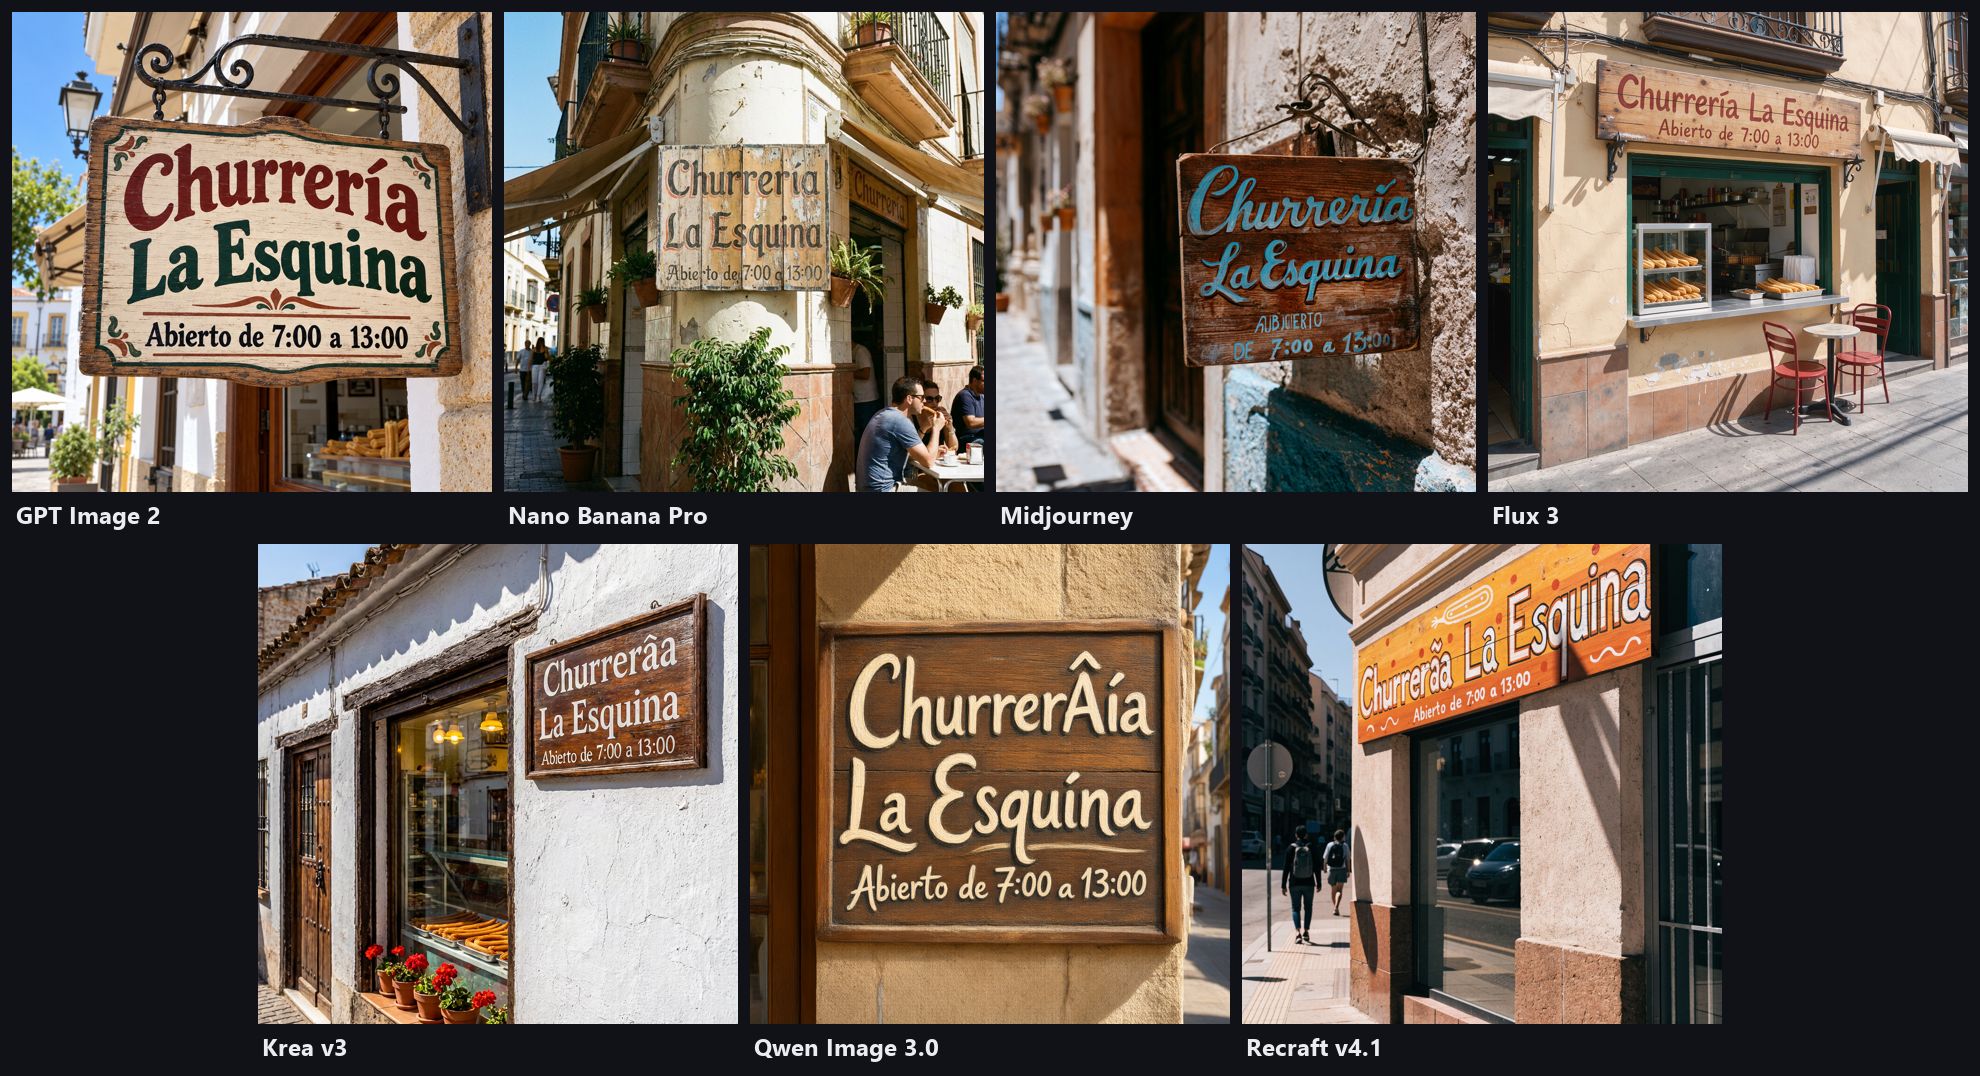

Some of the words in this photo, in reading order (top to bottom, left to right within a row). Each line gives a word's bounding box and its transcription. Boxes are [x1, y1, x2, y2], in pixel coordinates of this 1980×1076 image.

[1617, 73, 1739, 120] Churrería
[1749, 92, 1774, 123] La
[1782, 97, 1849, 135] Esquina
[1658, 118, 1712, 139] Abierto
[1719, 125, 1734, 141] de
[1741, 127, 1770, 144] 7:00
[1775, 134, 1782, 145] a
[1787, 132, 1819, 149] 13:00
[123, 143, 427, 241] Churrería
[666, 159, 821, 197] Churrería
[1187, 164, 1413, 237] Churrería
[665, 212, 700, 249] La
[711, 211, 823, 258] Esquina
[126, 237, 204, 305] La
[213, 219, 433, 303] Esquina
[723, 264, 737, 281] de
[743, 264, 771, 281] 7:00
[787, 265, 823, 281] 13:00
[1199, 241, 1255, 303] La
[1260, 239, 1402, 302] Esquina
[145, 321, 231, 347] Abierto
[239, 322, 264, 347] de
[271, 324, 322, 348] 7:00
[330, 330, 342, 348] a
[350, 325, 409, 349] 13:00
[1233, 341, 1254, 360] DE
[1270, 338, 1313, 360] 7:00
[1322, 339, 1335, 353] a
[1463, 622, 1499, 683] La
[1507, 558, 1652, 681] Esquina
[543, 633, 678, 697] Churrerâa
[539, 706, 565, 741] La
[571, 689, 680, 740] Esquina
[849, 650, 1155, 749] ChurrerÂía
[1412, 700, 1447, 724] Abierto
[1449, 694, 1462, 711] de
[1466, 687, 1486, 706] 7:00
[1489, 687, 1498, 698] a
[1500, 670, 1531, 693] 13:00
[541, 750, 577, 766] Abierto
[580, 746, 593, 763] de
[596, 742, 622, 760] 7:00
[625, 746, 633, 758] a
[638, 735, 676, 757] 13:00
[839, 756, 919, 853] La
[846, 864, 949, 912] Abierto
[958, 864, 989, 900] de
[995, 866, 1052, 904] 7:00
[1058, 881, 1075, 899] a
[1081, 866, 1147, 899] 13:00
